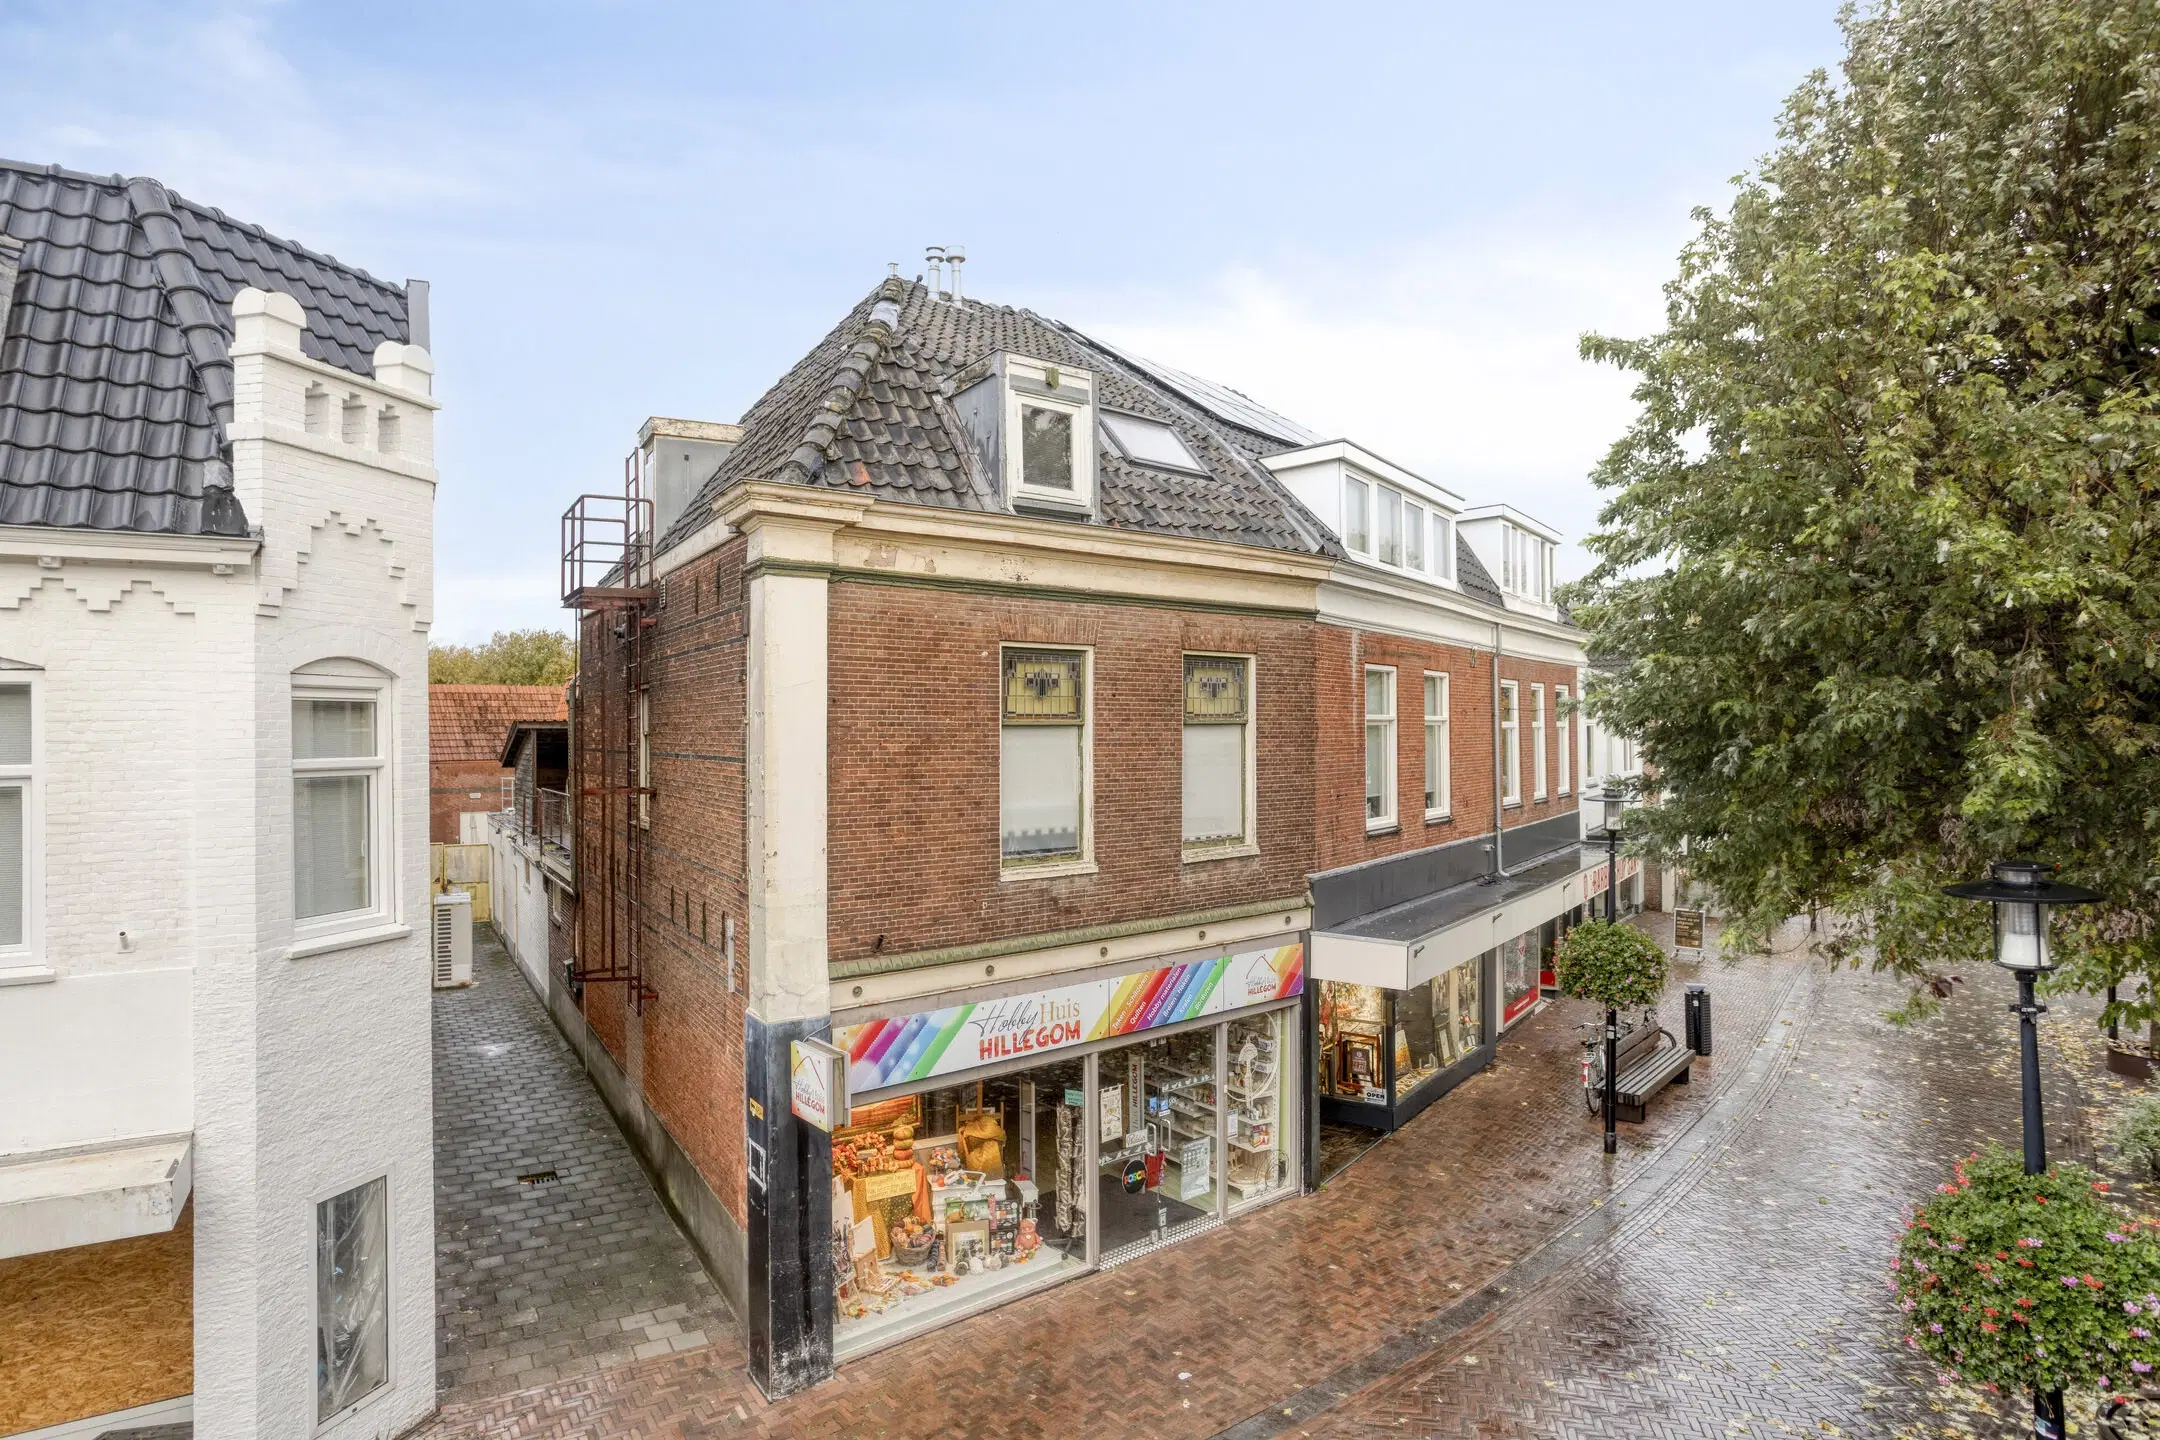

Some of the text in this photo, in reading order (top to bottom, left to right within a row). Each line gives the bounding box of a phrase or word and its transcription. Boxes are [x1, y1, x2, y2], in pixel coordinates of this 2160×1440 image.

[1126, 974, 1149, 1008] Schilderen
[1147, 967, 1182, 1021] Hobby materialen
[1163, 974, 1191, 1018] Breien Haken
[1248, 984, 1276, 996] HILLEGOM
[968, 1000, 1081, 1046] Hobby Huis
[1130, 1001, 1147, 1025] Quilten
[979, 1019, 1081, 1060] HILLEGOM
[796, 1092, 824, 1113] HILLEGOM
[1124, 1170, 1145, 1185] POSCA
